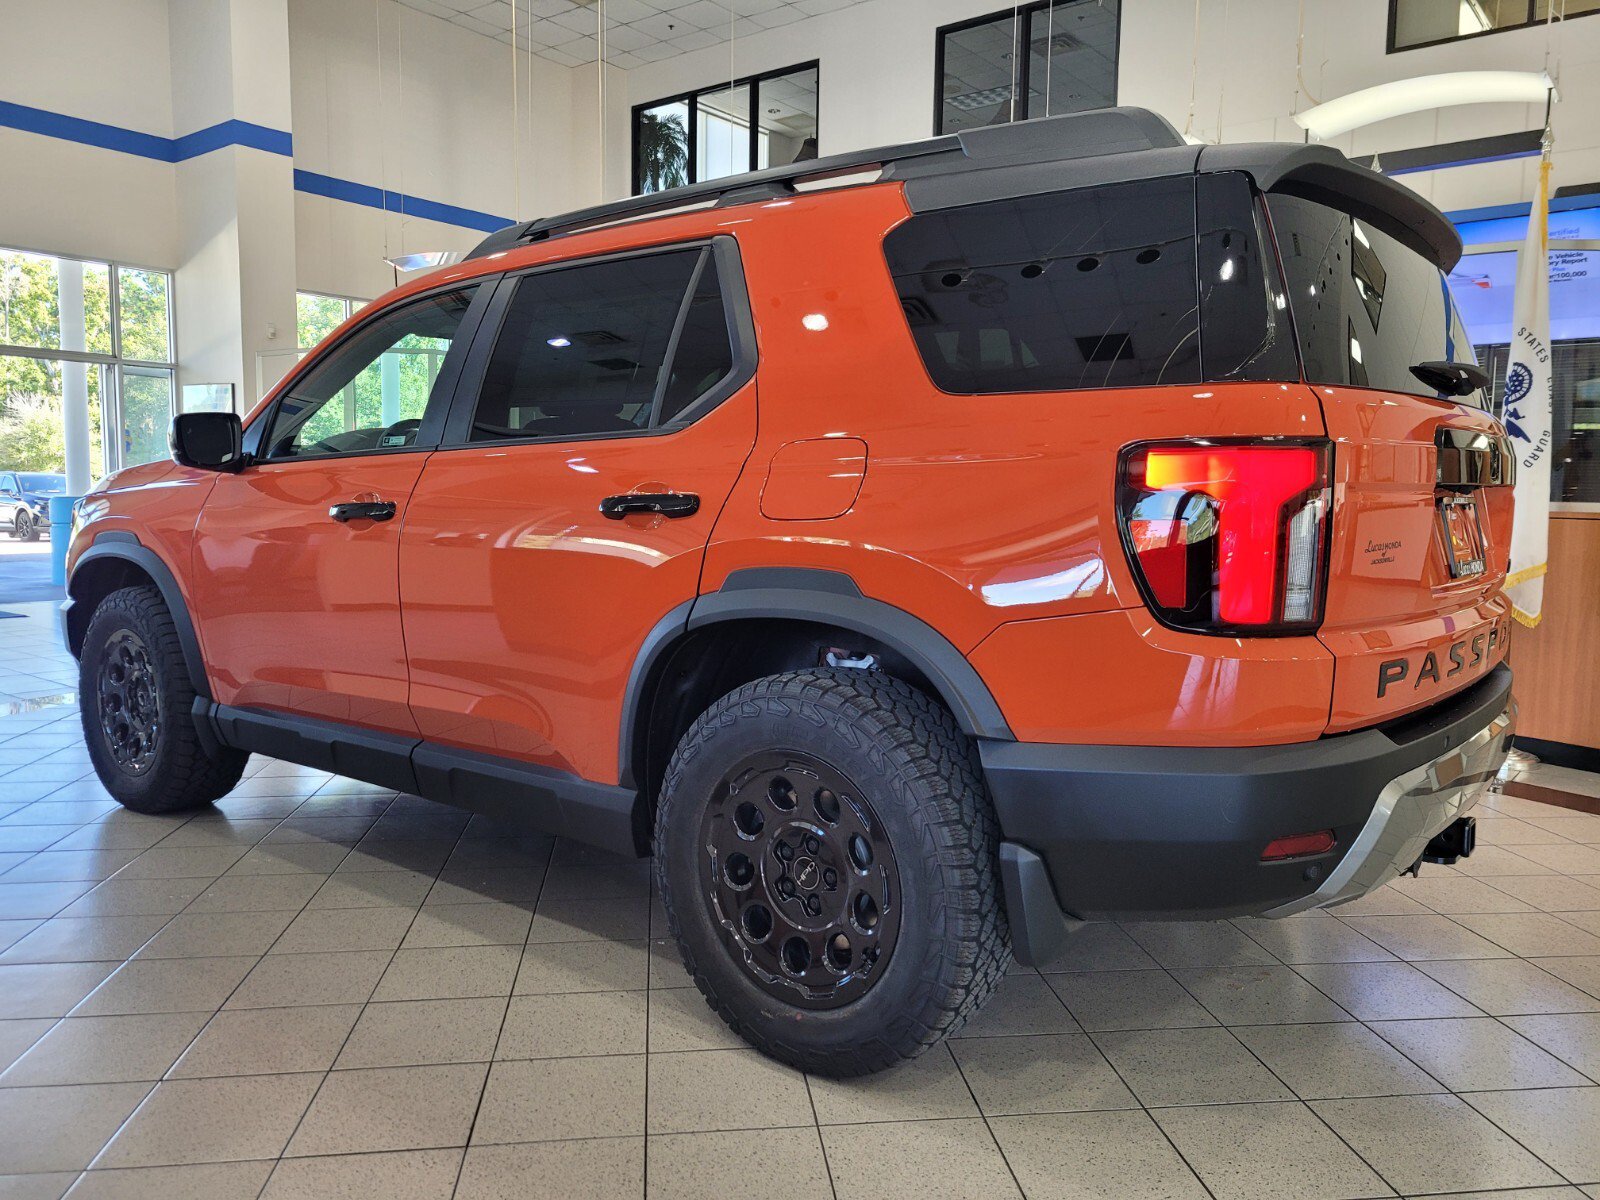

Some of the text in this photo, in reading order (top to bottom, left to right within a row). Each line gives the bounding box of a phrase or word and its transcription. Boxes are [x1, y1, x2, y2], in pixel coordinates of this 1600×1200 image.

[1549, 227, 1580, 237] ertified
[1555, 251, 1583, 259] Vehicle
[1561, 257, 1587, 265] Report
[1518, 327, 1549, 363] STATES
[1523, 430, 1550, 468] GUARD
